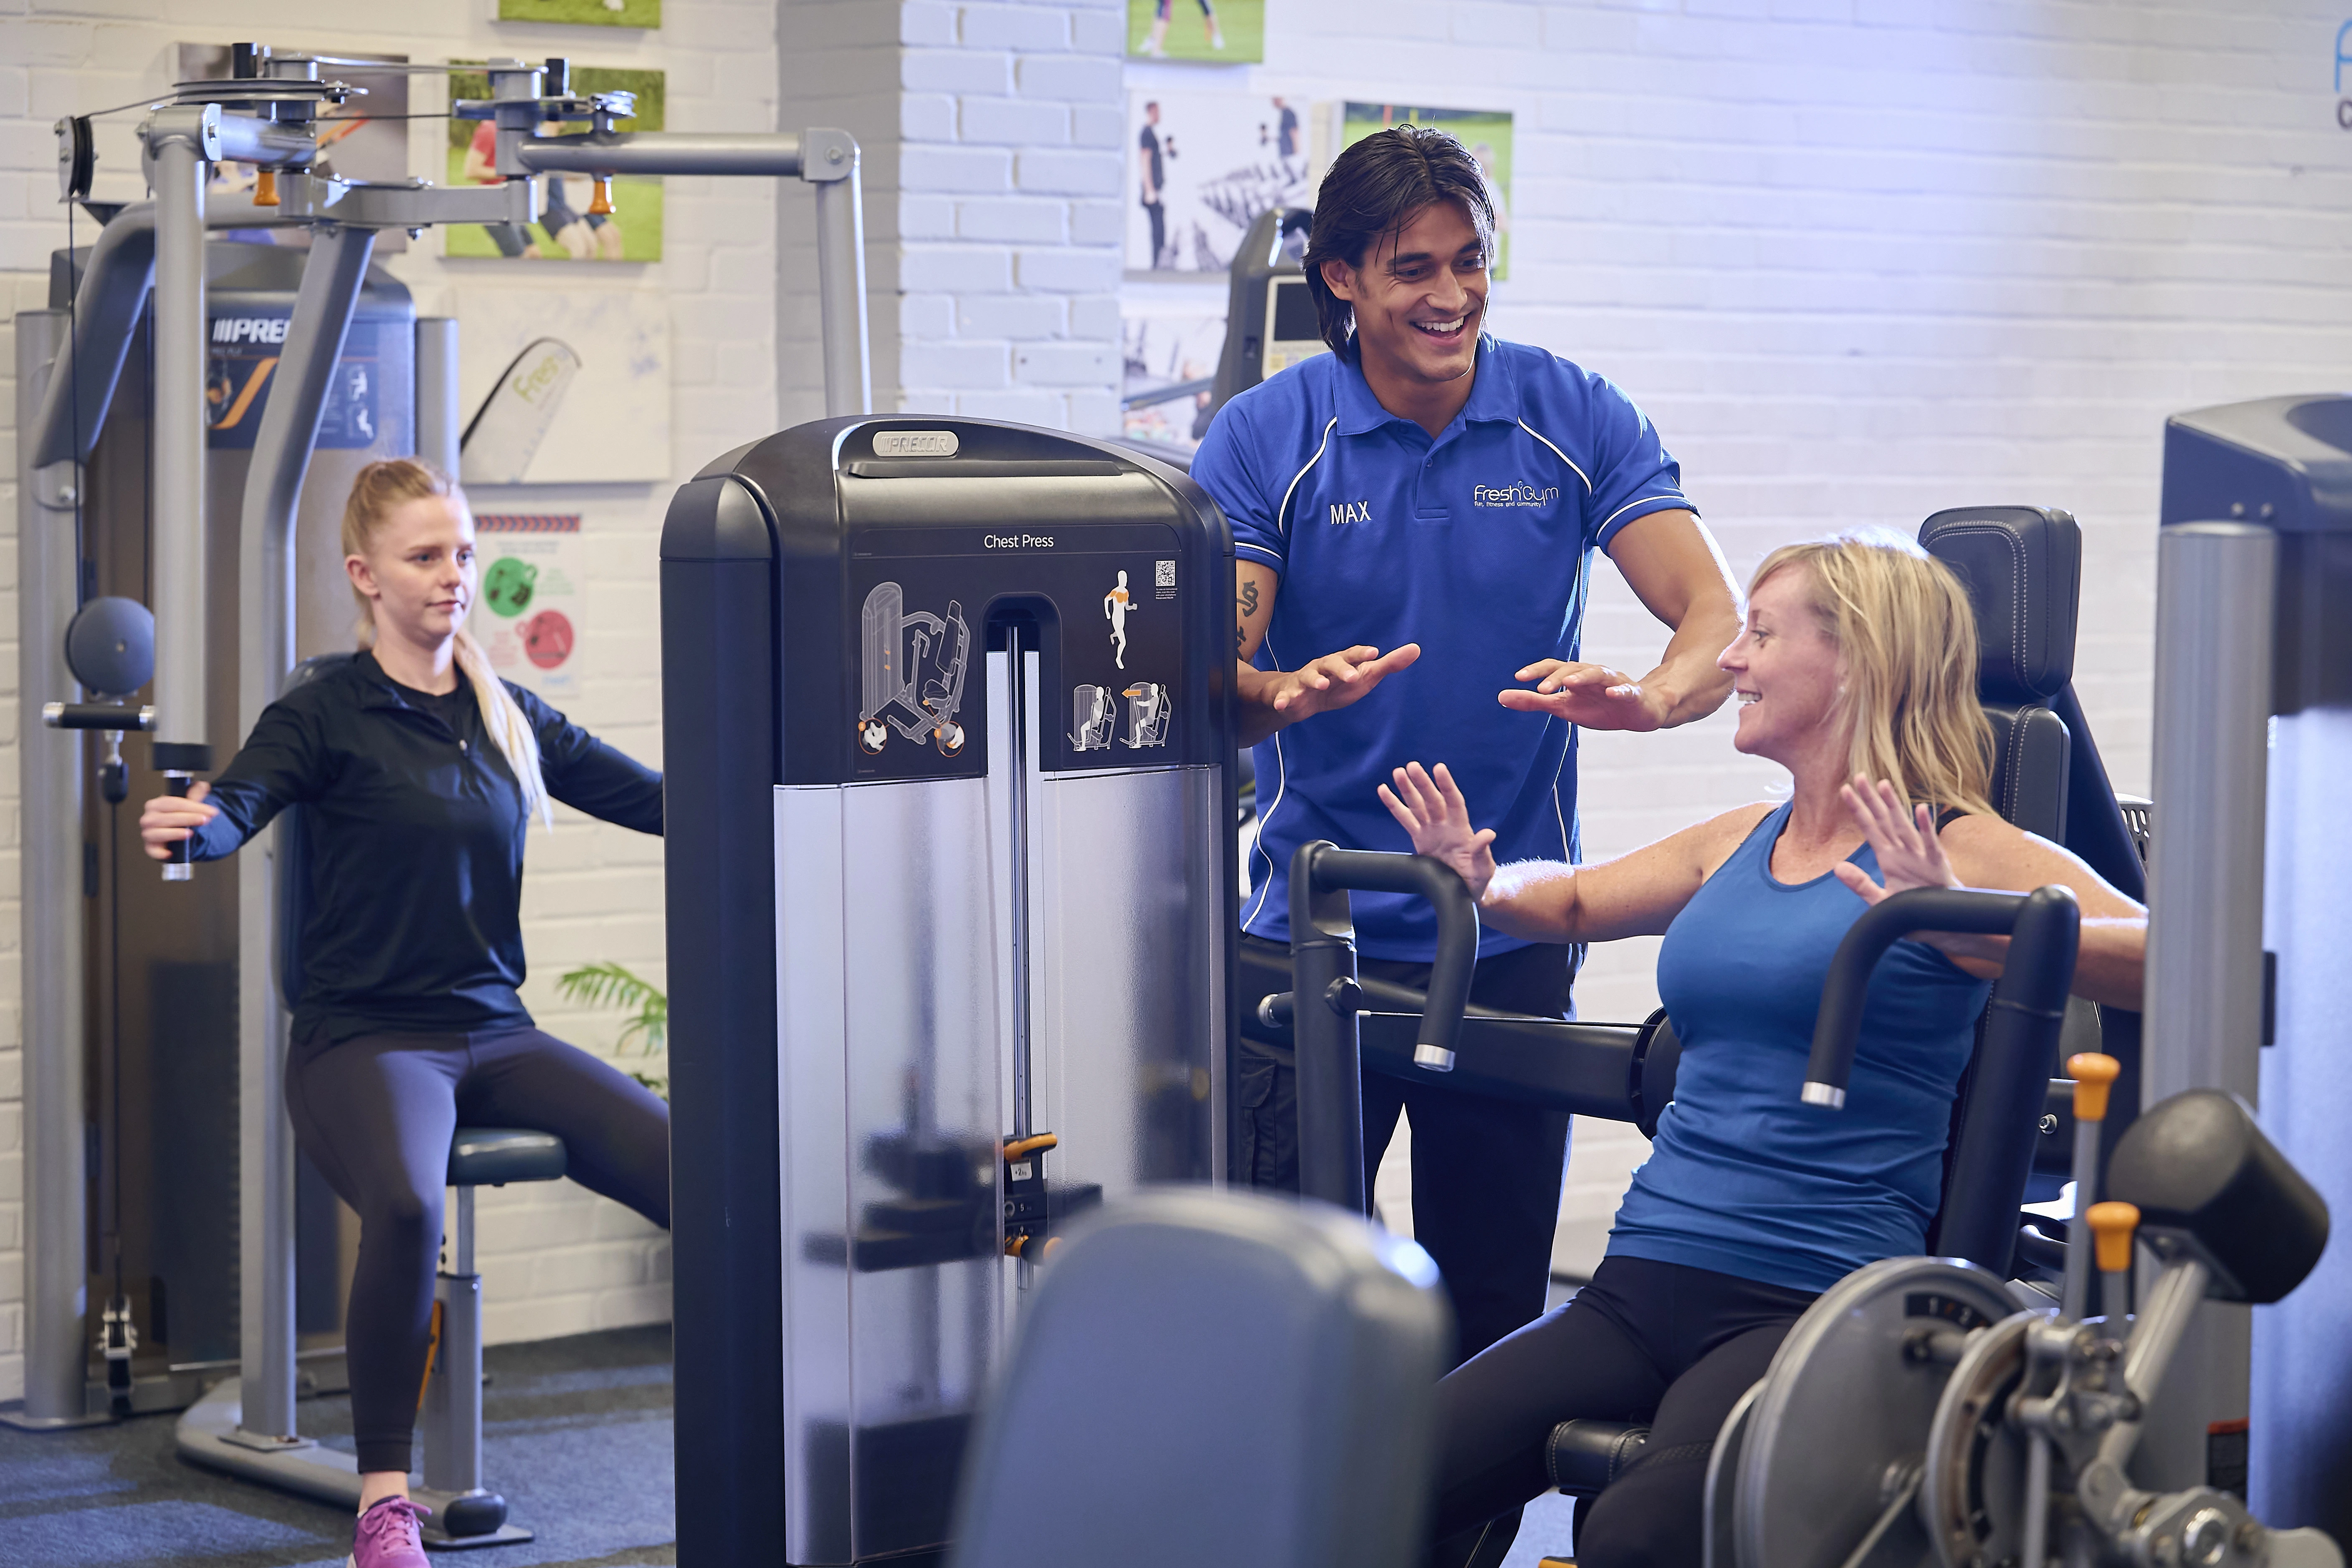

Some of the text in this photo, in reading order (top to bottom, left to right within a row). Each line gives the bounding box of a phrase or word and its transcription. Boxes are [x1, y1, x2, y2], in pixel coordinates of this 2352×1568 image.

[232, 319, 291, 343] PRE
[889, 436, 948, 452] PRECOR
[1330, 501, 1372, 525] MAX
[984, 534, 1054, 548] Chest Press
